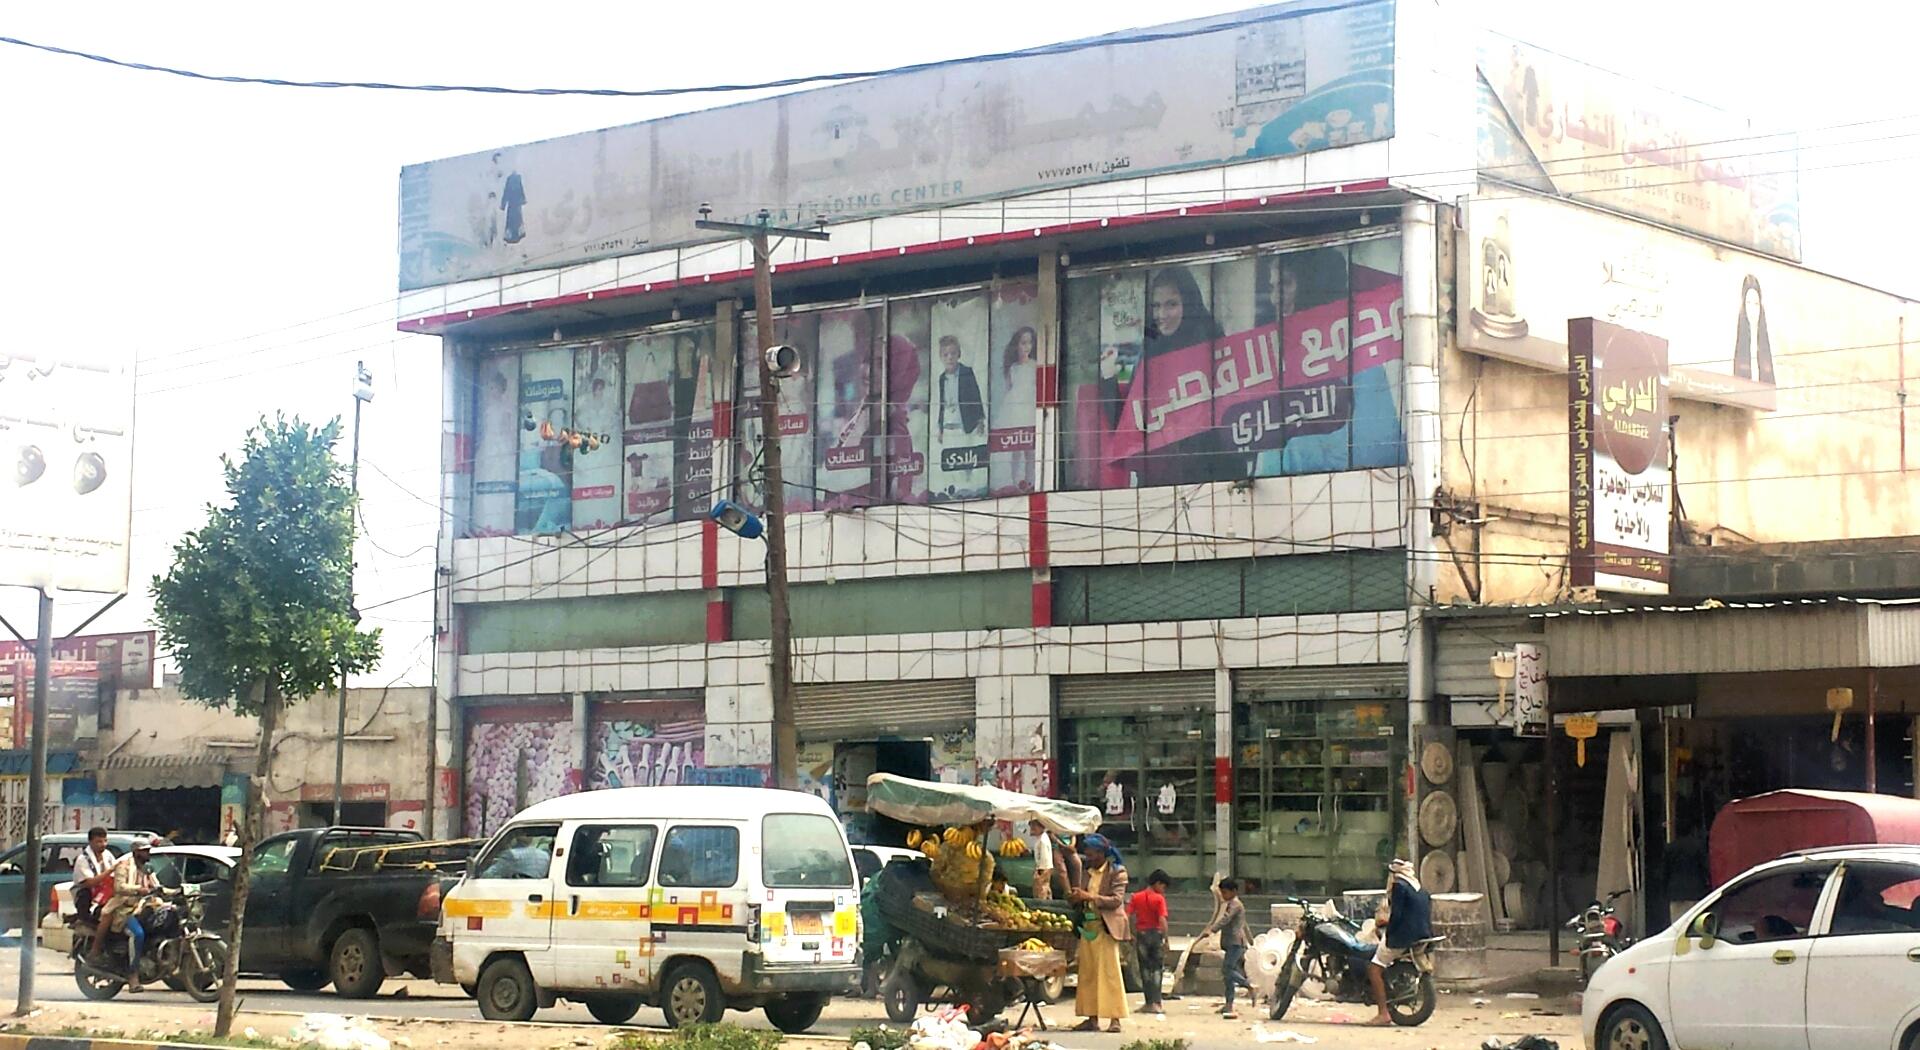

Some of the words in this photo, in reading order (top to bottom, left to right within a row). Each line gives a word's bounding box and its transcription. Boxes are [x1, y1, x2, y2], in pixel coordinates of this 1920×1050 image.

[1102, 157, 1131, 174] تلفون
[891, 180, 964, 204] CENTER
[1602, 375, 1659, 421] الدربي
[1231, 384, 1335, 452] التجاري
[1000, 430, 1034, 449] بناتي
[1599, 468, 1630, 500] الجاهزة
[1632, 480, 1664, 507] للملابس
